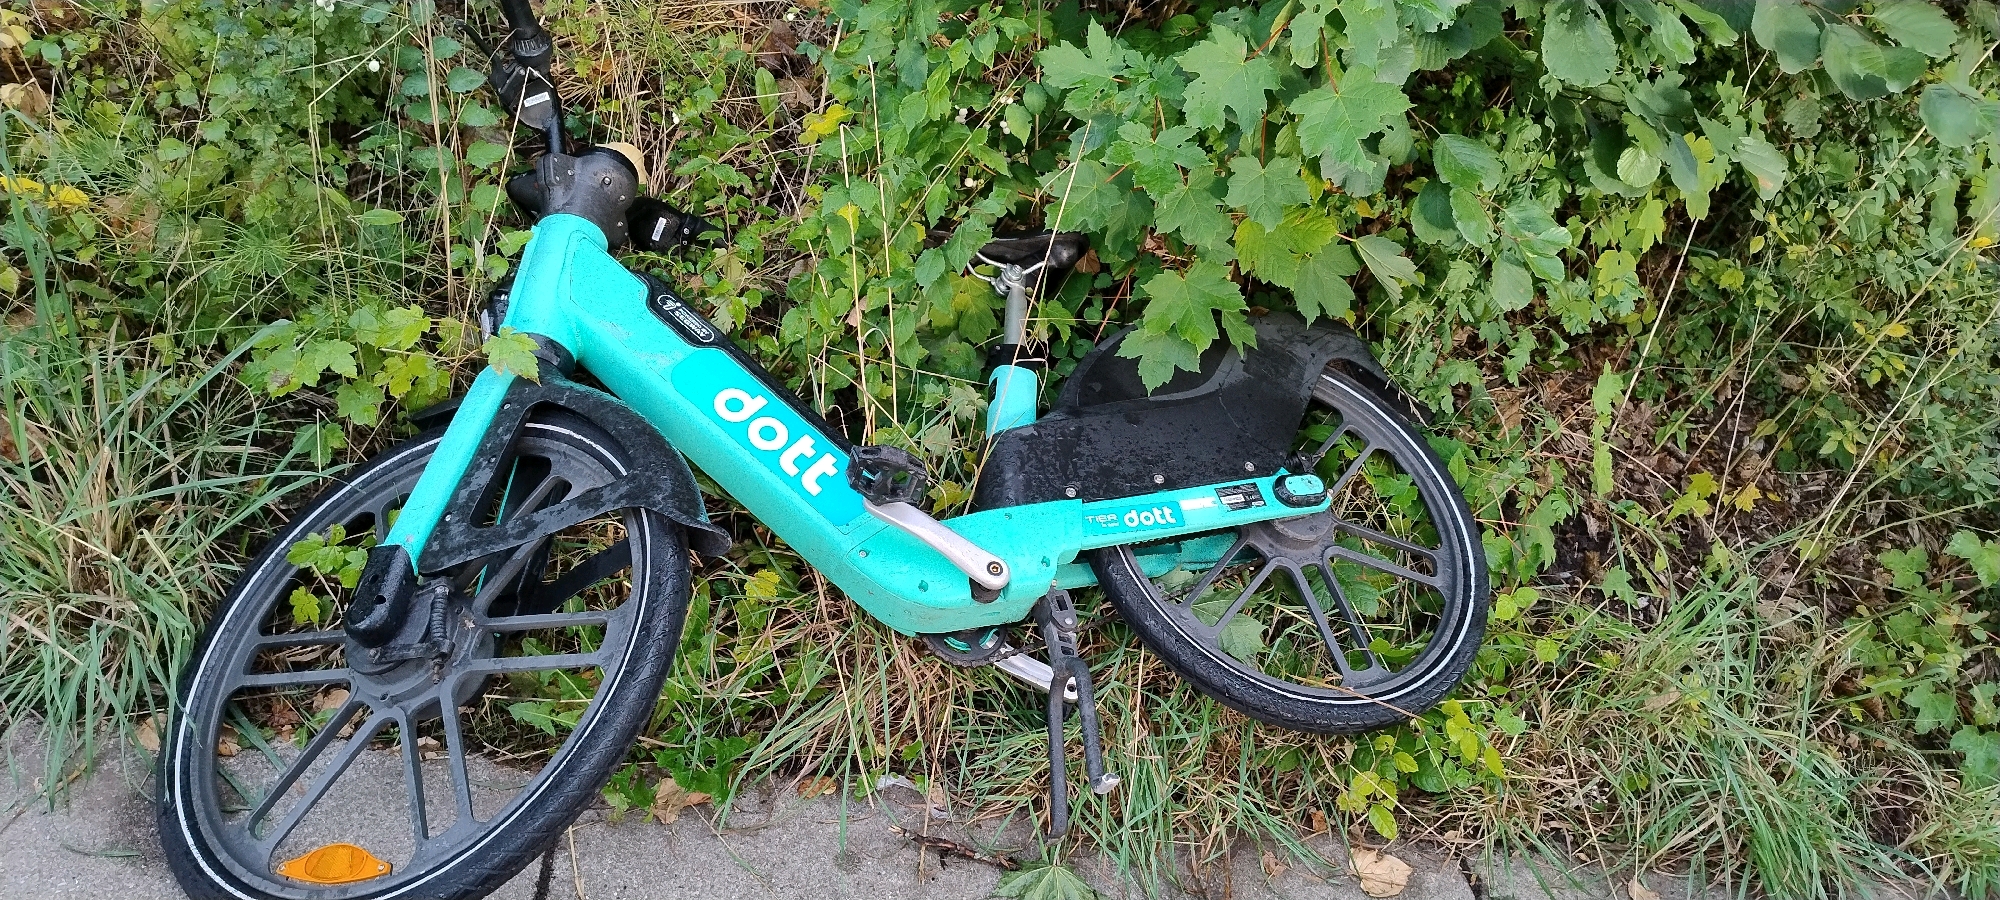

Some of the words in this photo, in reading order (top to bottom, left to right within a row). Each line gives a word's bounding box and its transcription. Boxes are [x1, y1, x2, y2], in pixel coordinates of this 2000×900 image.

[673, 310, 707, 337] SEGWAY
[713, 387, 839, 497] dott
[1084, 513, 1119, 524] TIER
[1123, 506, 1177, 528] dott
